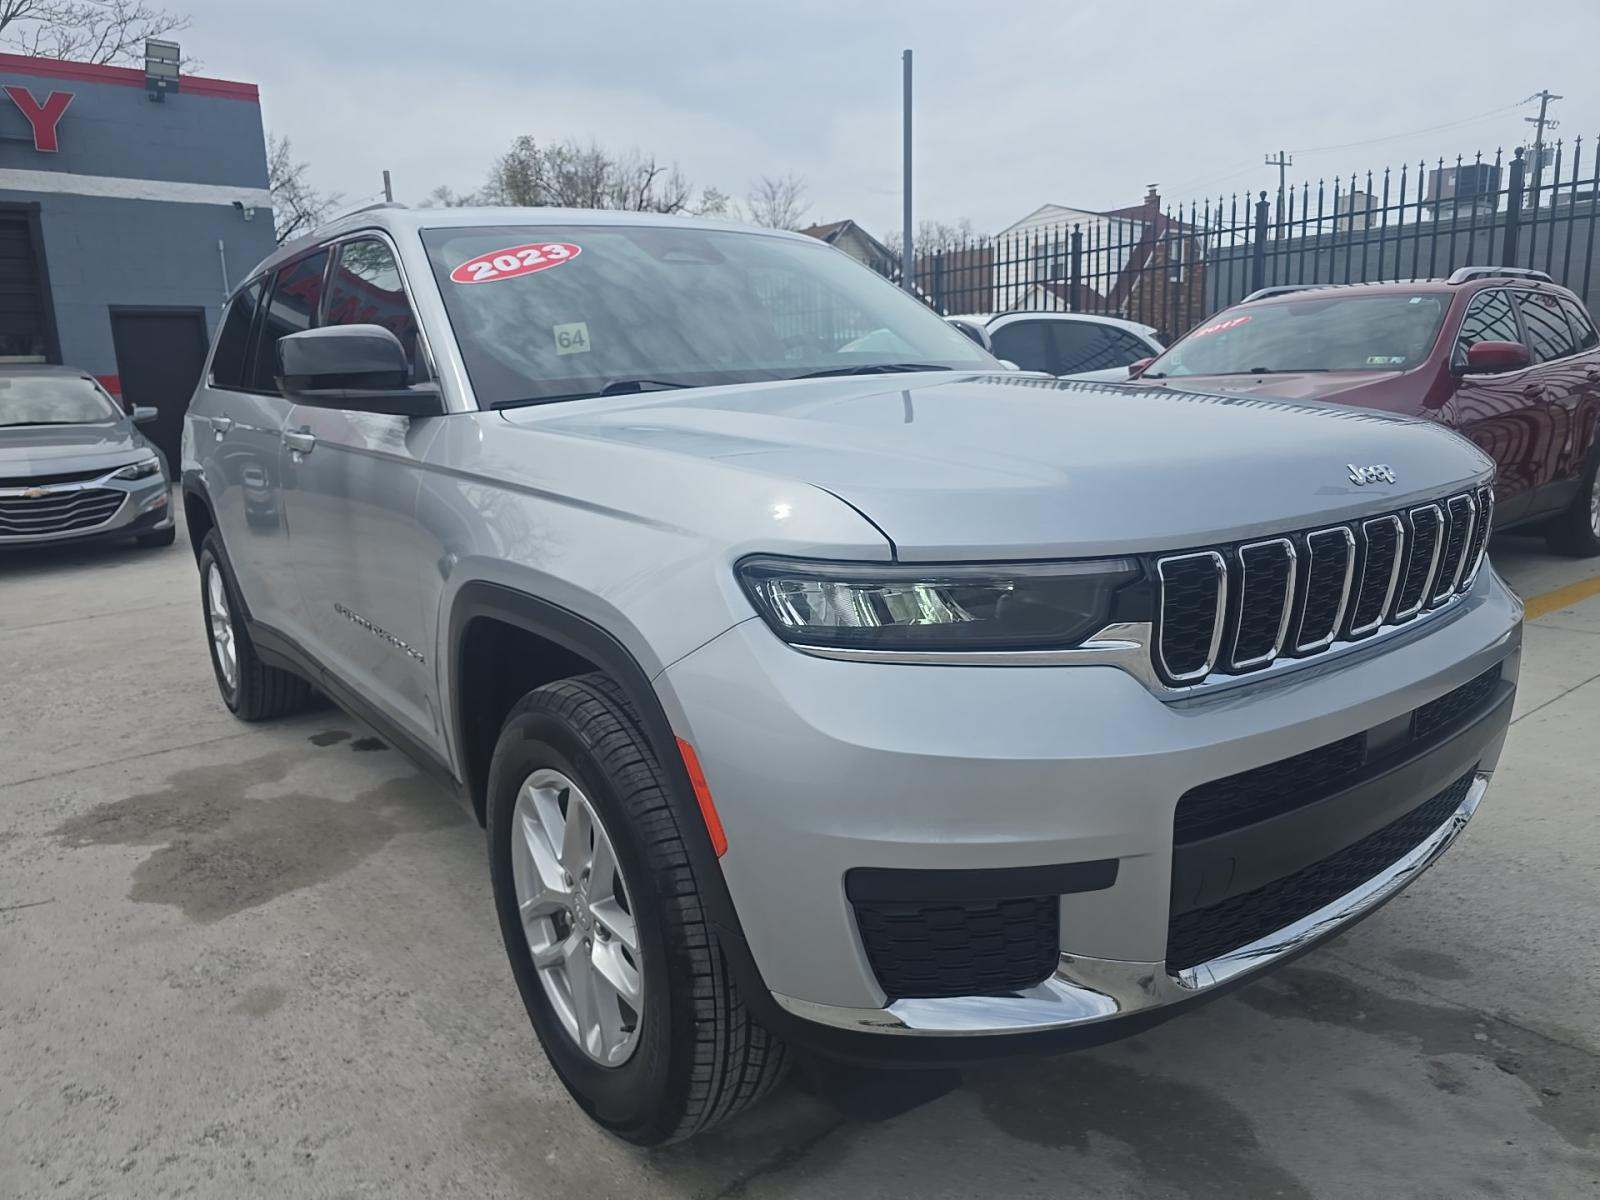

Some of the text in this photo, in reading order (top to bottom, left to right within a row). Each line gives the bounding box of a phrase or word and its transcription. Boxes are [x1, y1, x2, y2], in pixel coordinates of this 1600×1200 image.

[466, 244, 571, 281] 2023
[557, 329, 586, 349] 64
[1346, 463, 1397, 487] Jeep
